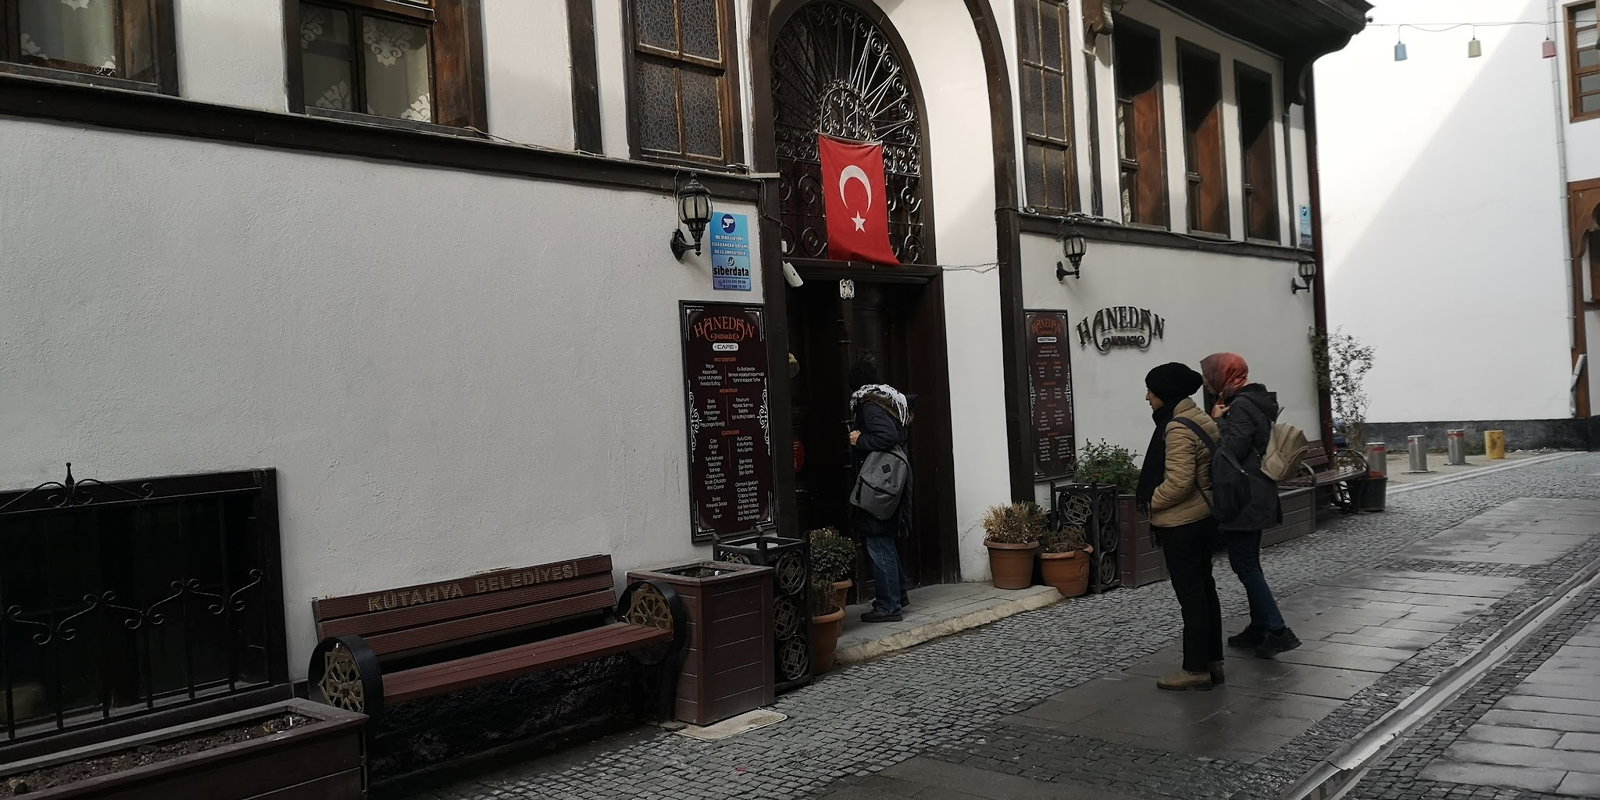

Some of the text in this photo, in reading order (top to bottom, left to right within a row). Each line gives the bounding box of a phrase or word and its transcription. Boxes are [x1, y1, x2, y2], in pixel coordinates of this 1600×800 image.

[714, 266, 749, 276] siberdata
[693, 316, 754, 341] HANEDAN
[1076, 306, 1165, 352] HANEDAN
[368, 561, 578, 612] KÜTAHYA BELEDİYESİ
